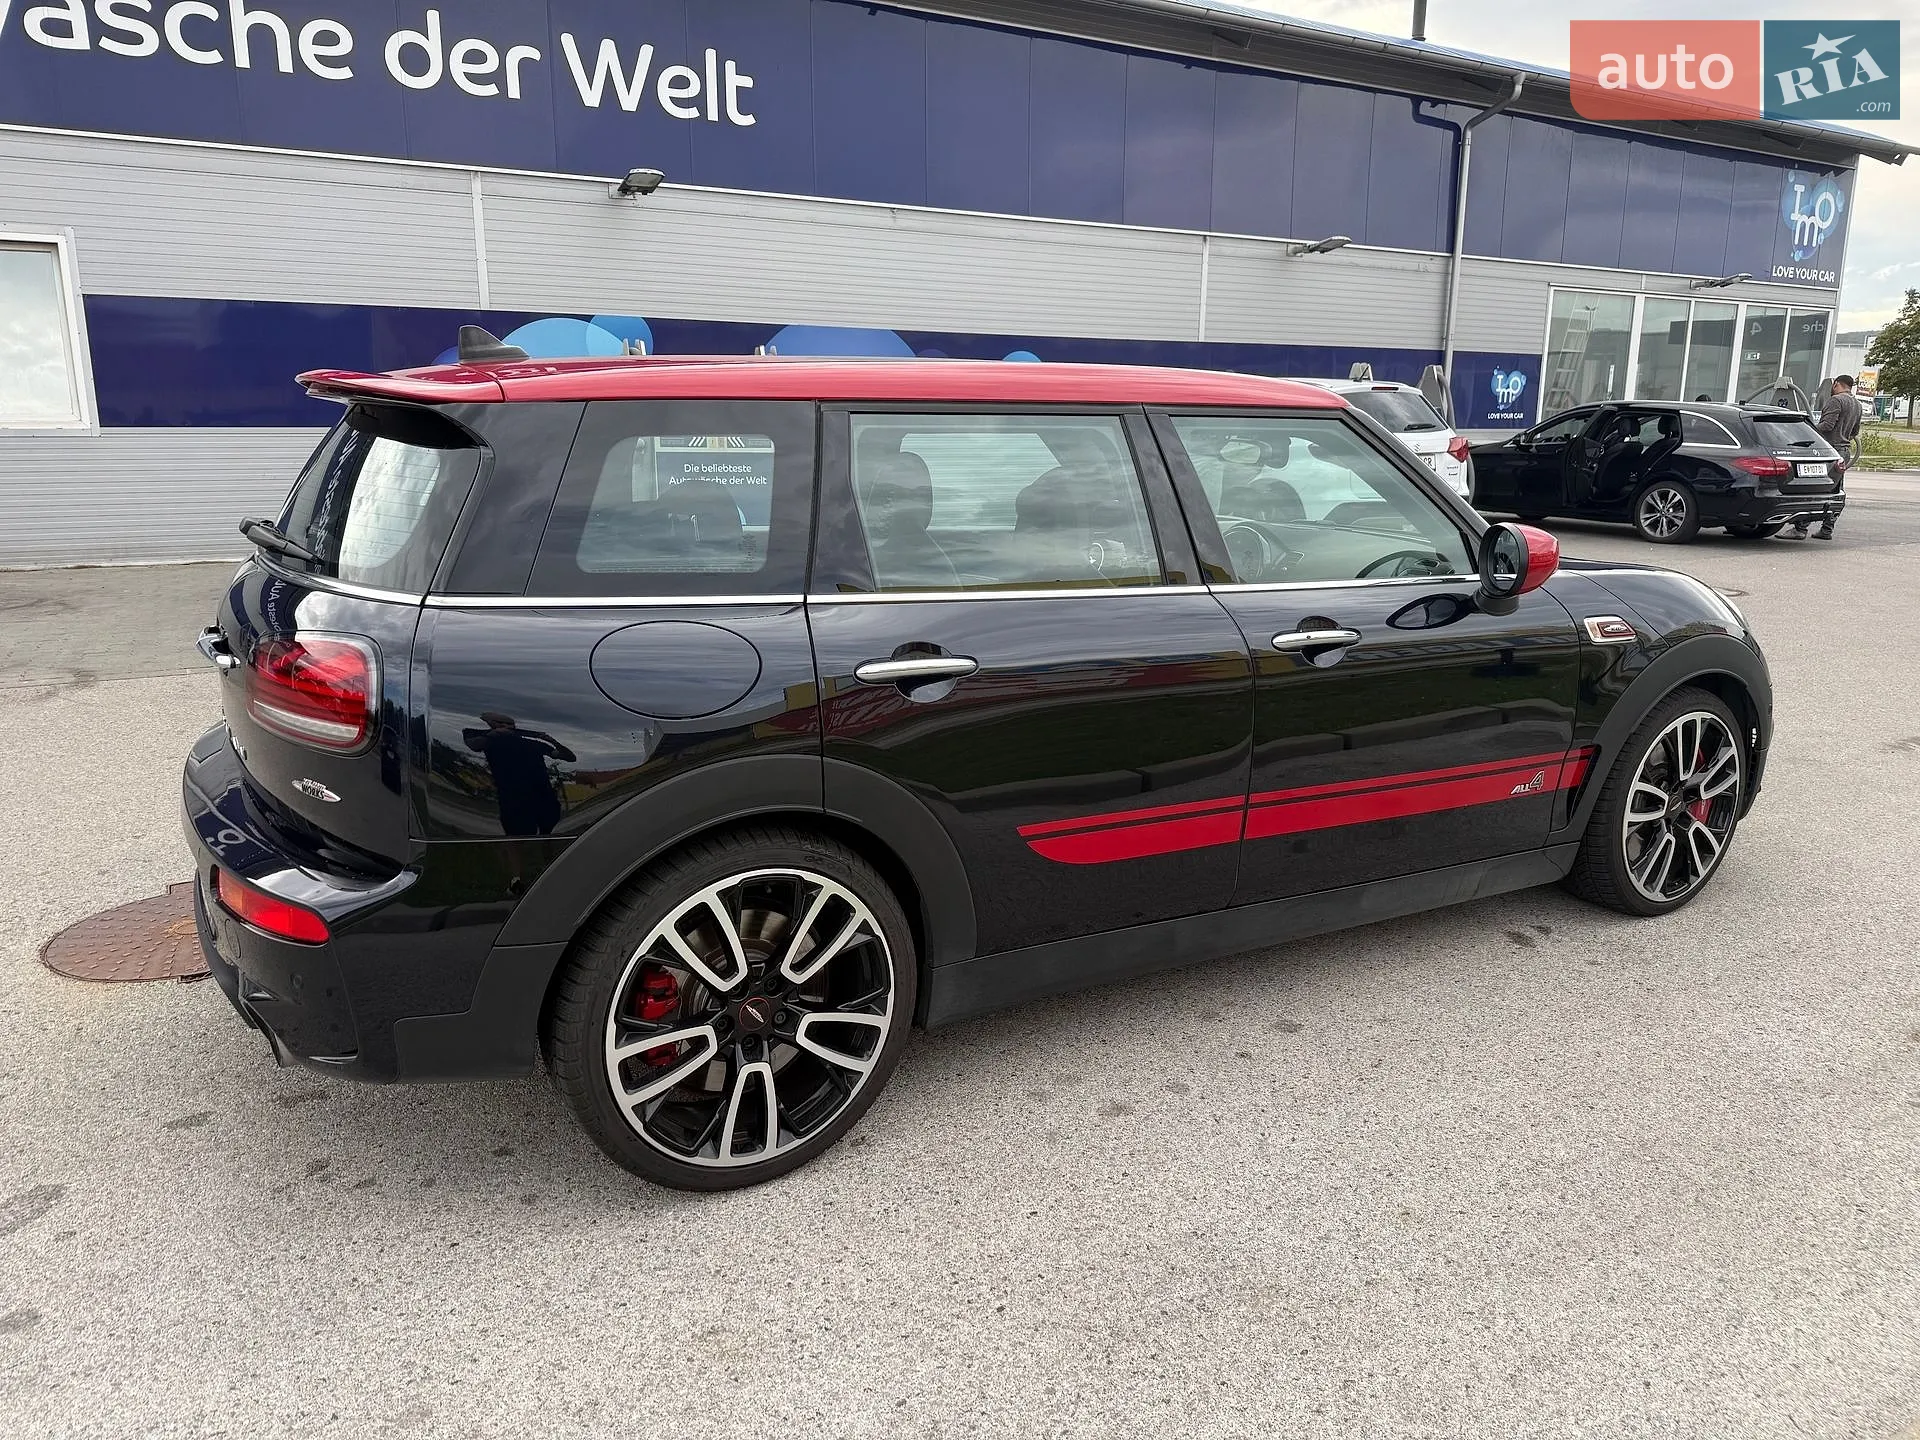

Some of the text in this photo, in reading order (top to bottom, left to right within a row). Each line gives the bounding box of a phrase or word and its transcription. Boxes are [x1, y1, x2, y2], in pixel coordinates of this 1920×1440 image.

[384, 9, 541, 100] der
[560, 32, 757, 126] Welt
[1772, 265, 1835, 283] LOVE YOUR CAR
[683, 463, 752, 473] Die beliebteste
[729, 476, 745, 485] der
[746, 476, 767, 485] Welt
